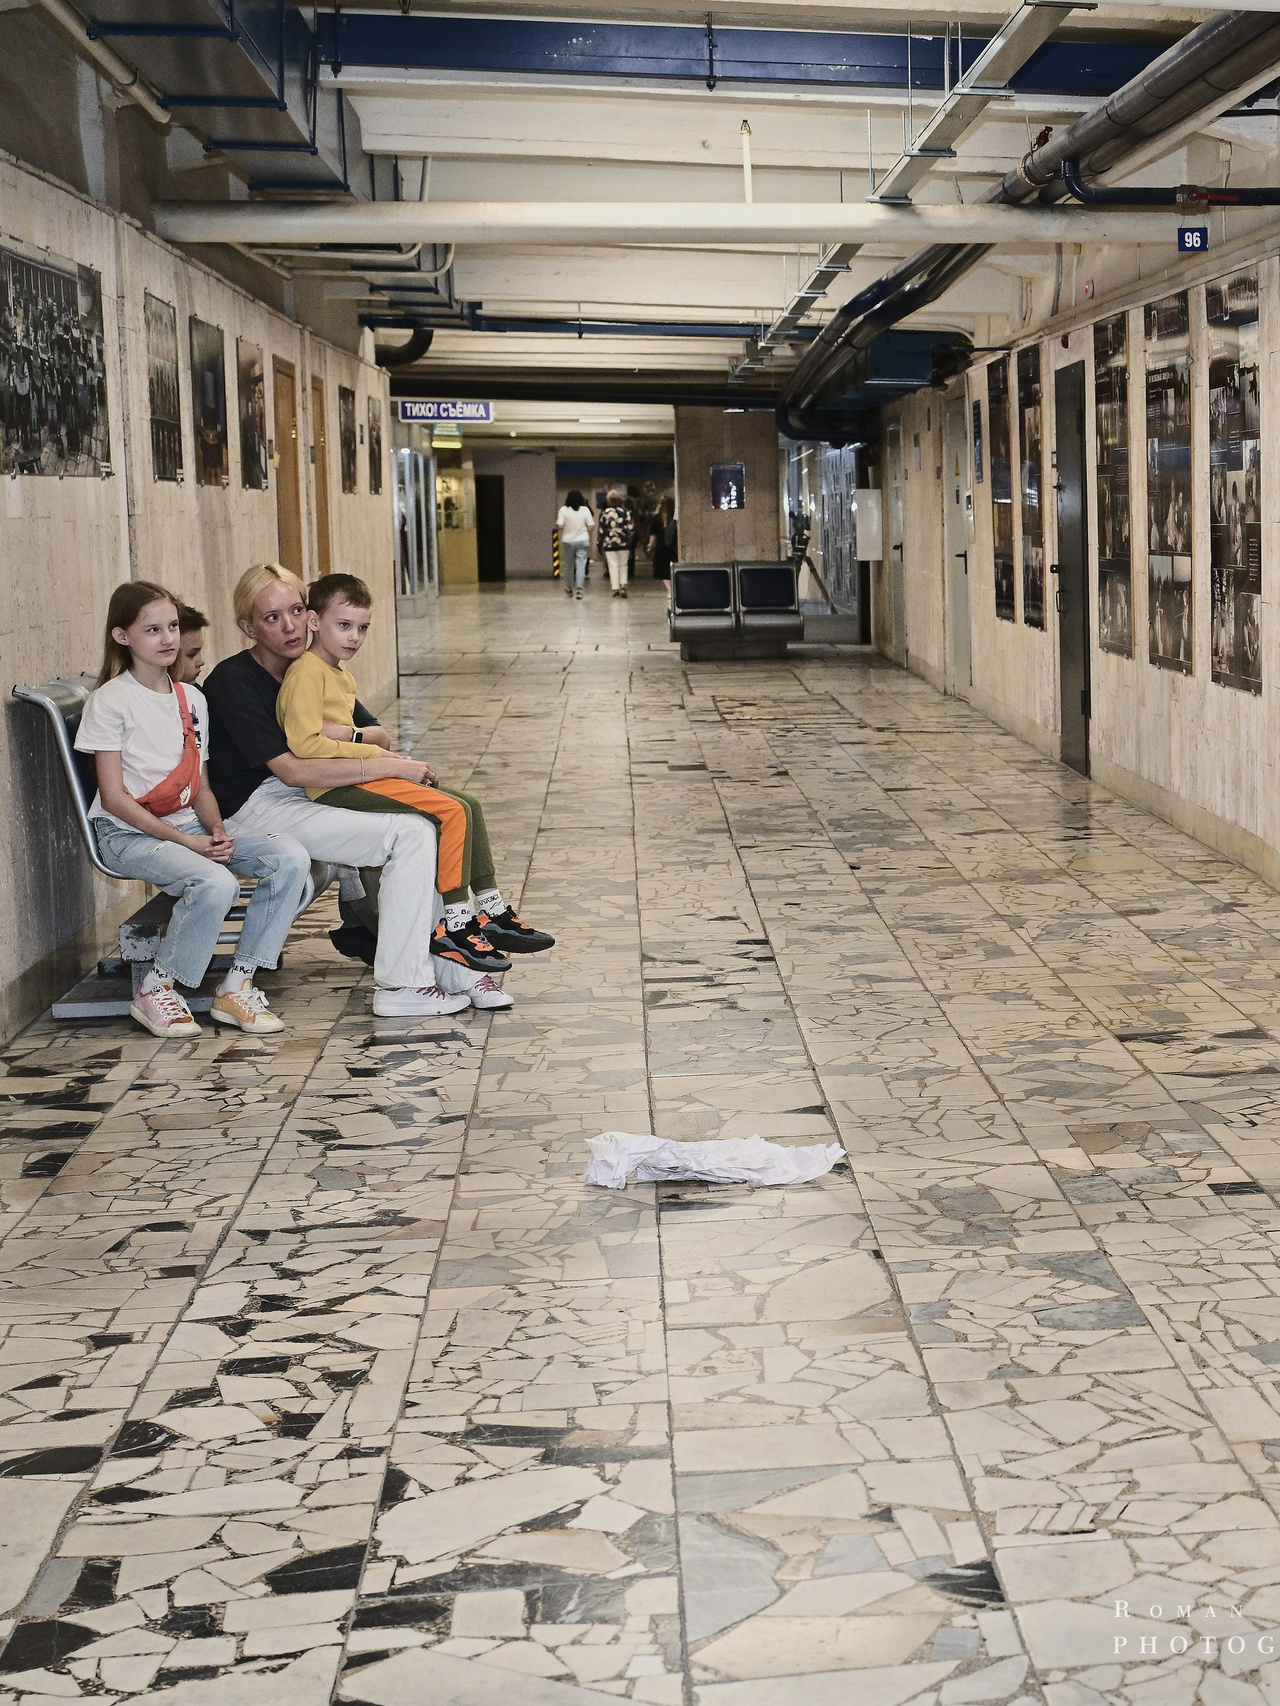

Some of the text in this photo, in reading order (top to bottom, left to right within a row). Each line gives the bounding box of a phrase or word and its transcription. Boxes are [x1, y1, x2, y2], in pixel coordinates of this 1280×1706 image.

[1184, 232, 1201, 248] 96
[404, 401, 487, 418] ТИХО! СЪЁМКА
